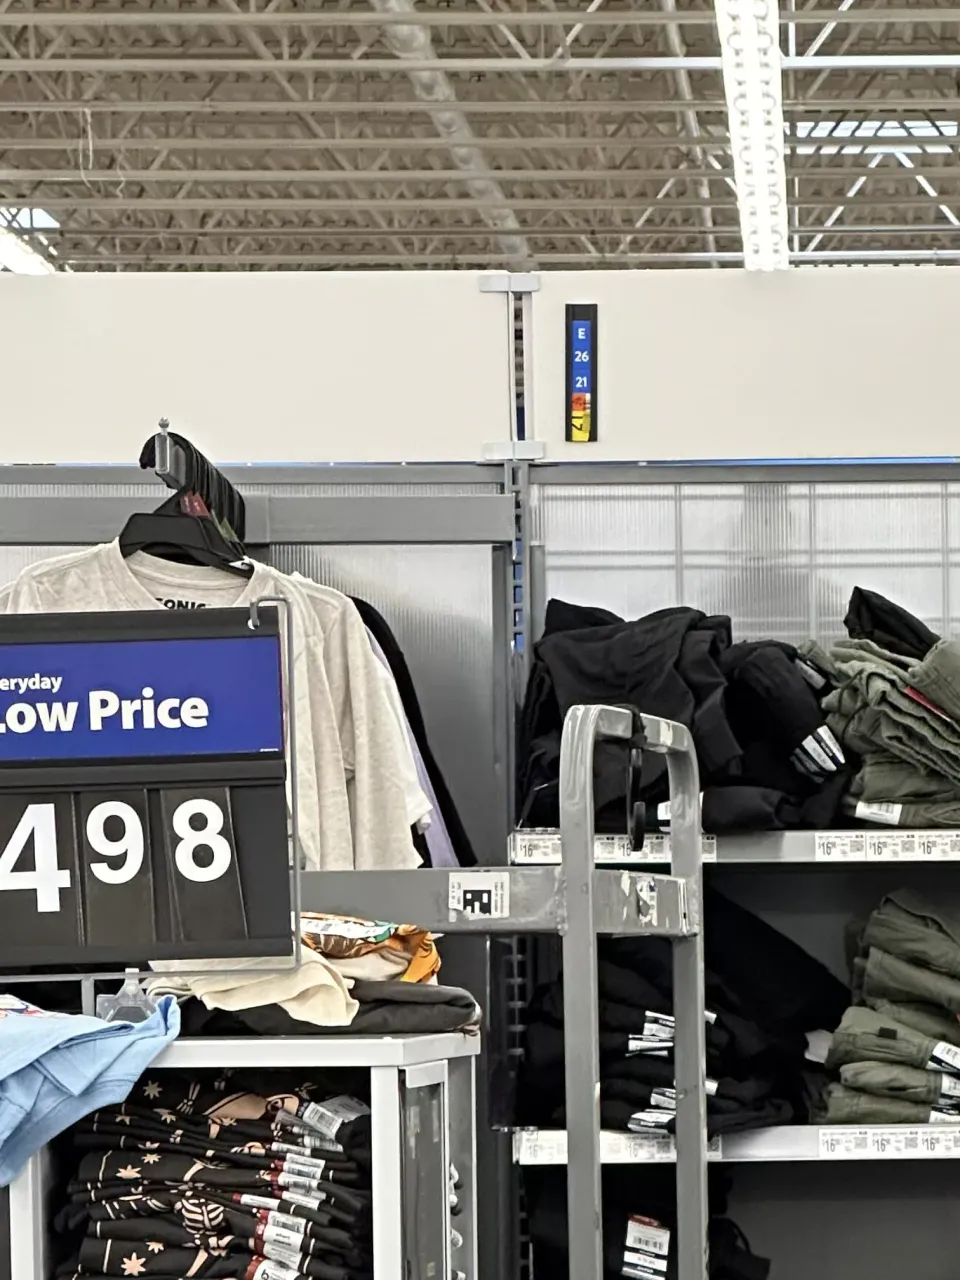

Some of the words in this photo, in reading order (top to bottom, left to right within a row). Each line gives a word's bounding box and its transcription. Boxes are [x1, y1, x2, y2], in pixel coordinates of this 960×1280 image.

[577, 327, 586, 340] E
[574, 350, 589, 363] 26
[575, 376, 587, 388] 21
[0, 700, 78, 734] ow
[88, 686, 210, 731] Price
